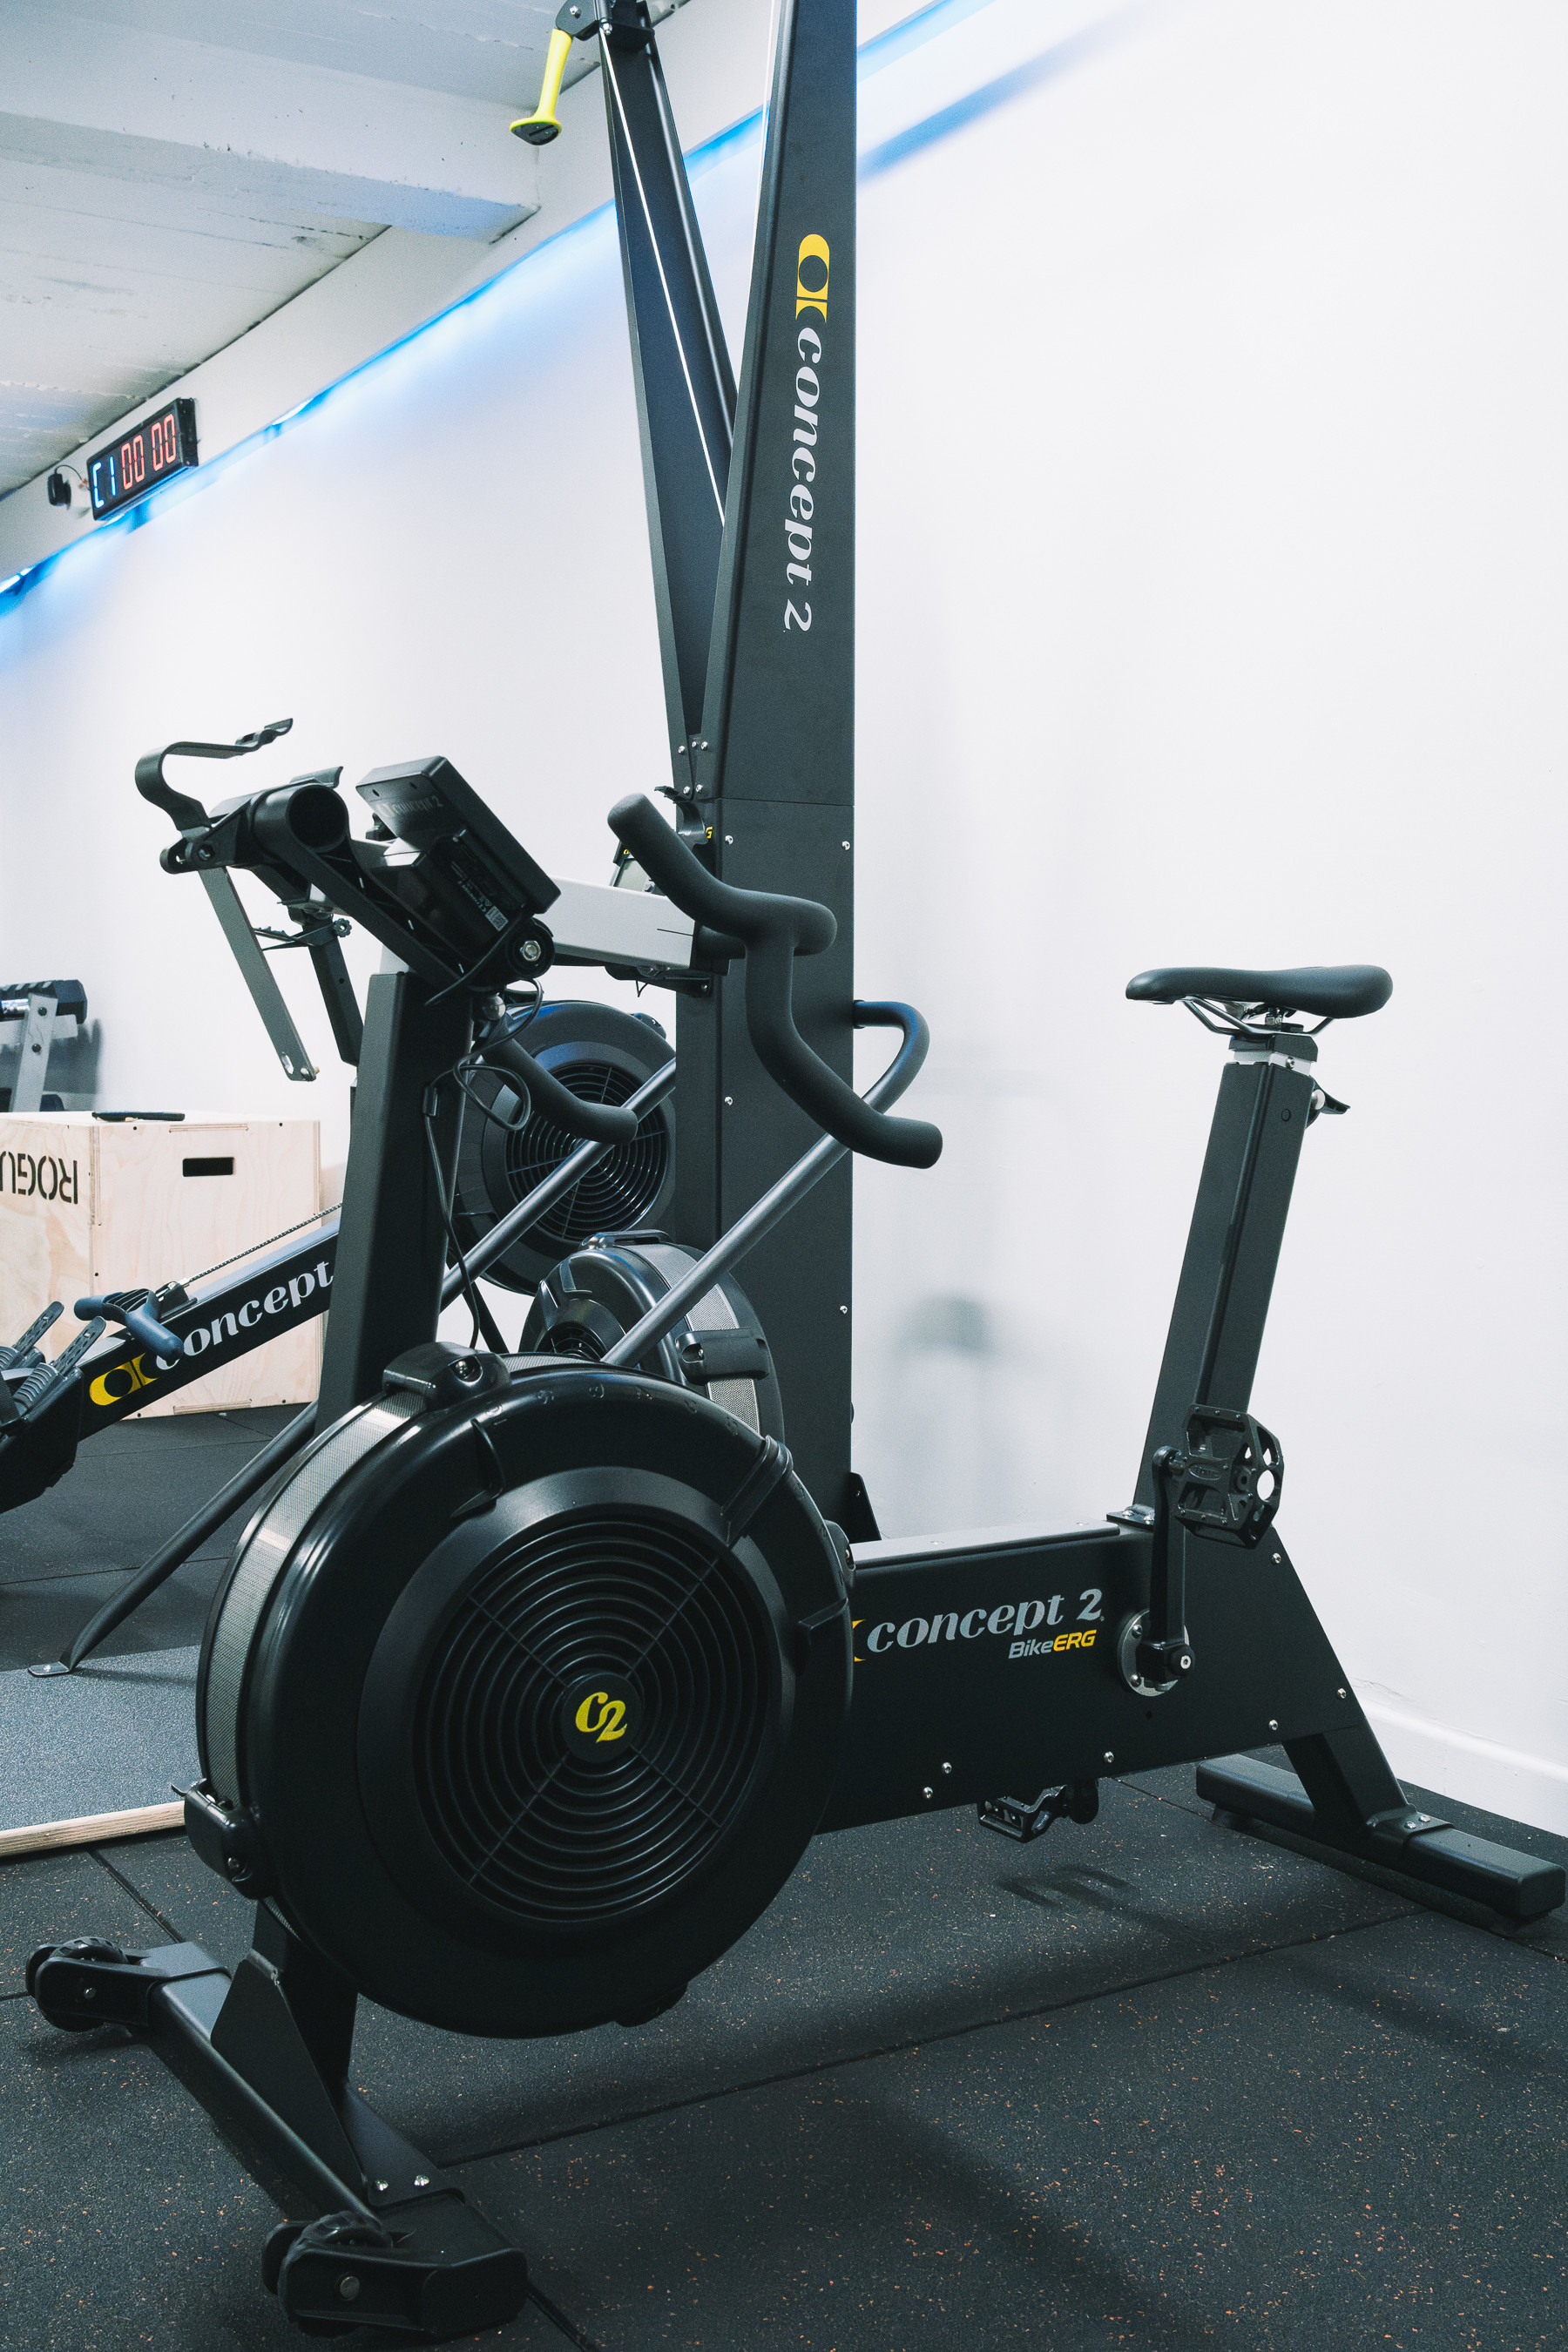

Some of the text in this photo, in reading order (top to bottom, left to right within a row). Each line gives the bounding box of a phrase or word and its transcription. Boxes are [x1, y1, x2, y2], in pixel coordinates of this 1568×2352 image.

[784, 327, 821, 632] concept 2
[867, 1588, 1103, 1652] concept 2
[1008, 1629, 1098, 1659] BikeERG
